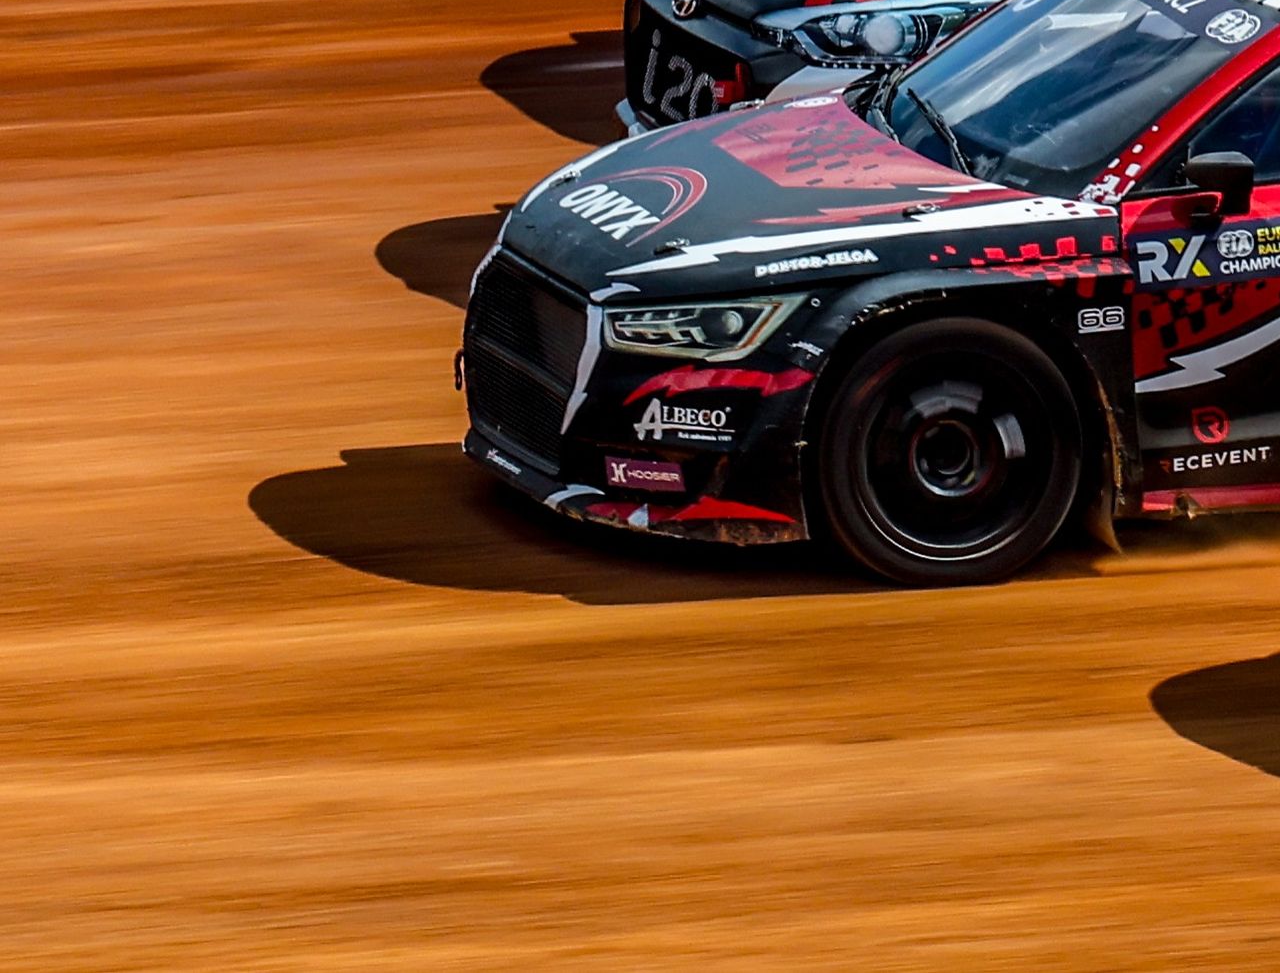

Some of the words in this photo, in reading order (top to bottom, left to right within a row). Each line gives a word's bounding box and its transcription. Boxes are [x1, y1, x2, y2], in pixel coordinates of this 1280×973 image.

[557, 183, 662, 241] ONYX
[1135, 234, 1212, 285] RX
[1218, 231, 1253, 256] FIA
[1077, 305, 1125, 329] 66
[633, 397, 728, 441] ALBECO
[626, 469, 681, 483] HOOSIER
